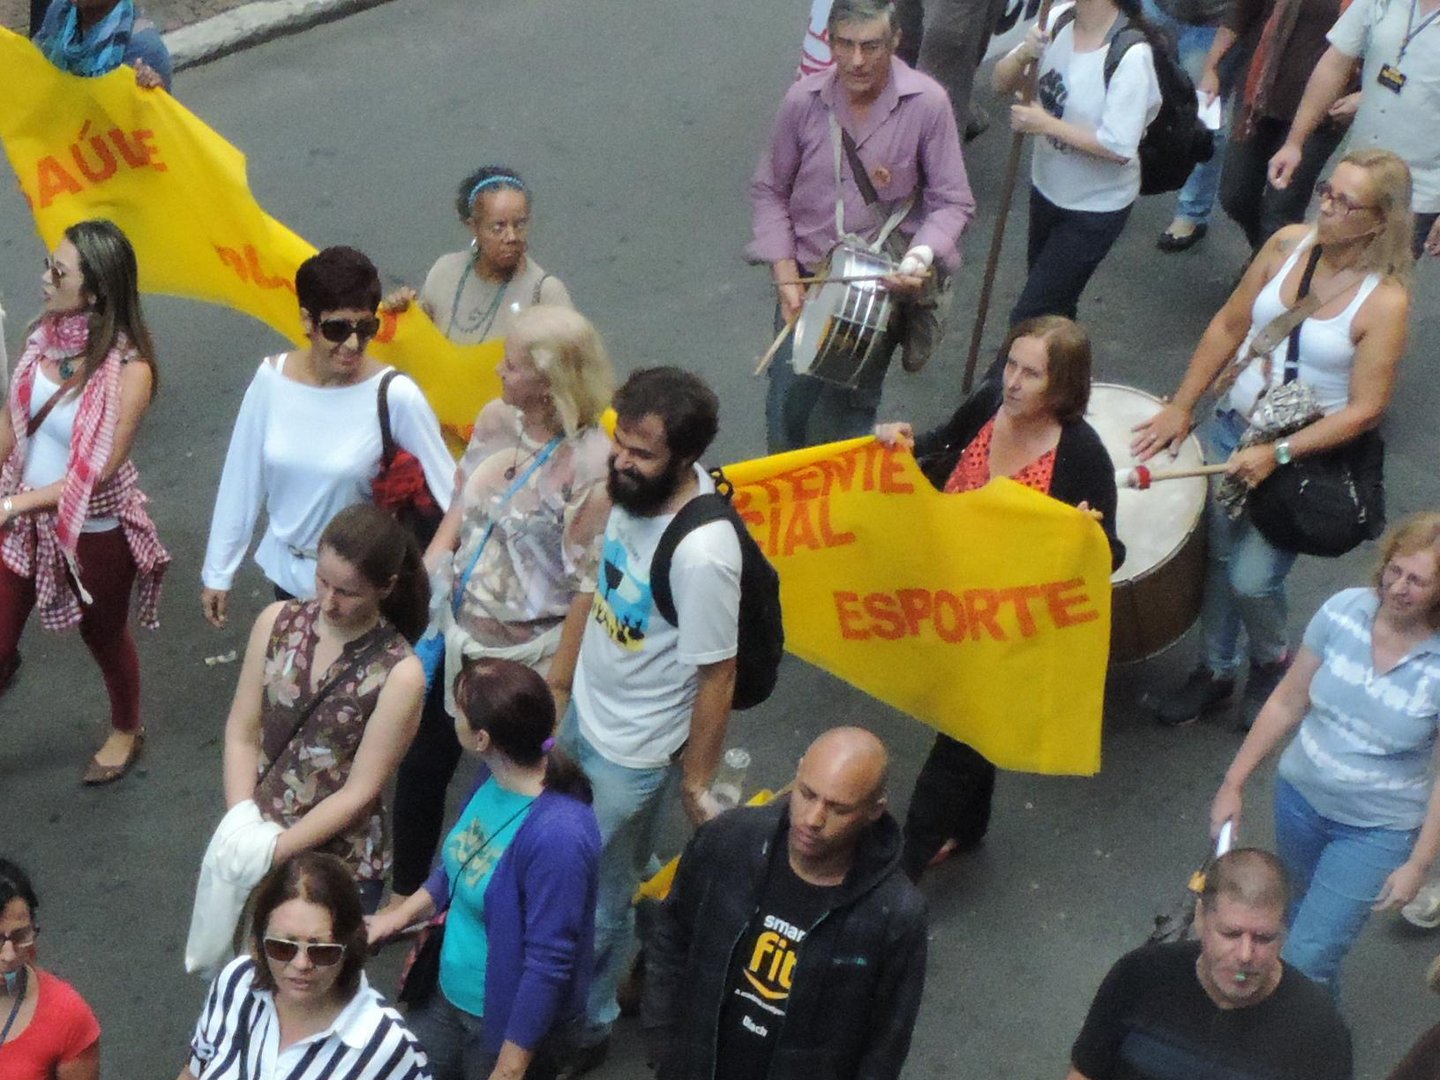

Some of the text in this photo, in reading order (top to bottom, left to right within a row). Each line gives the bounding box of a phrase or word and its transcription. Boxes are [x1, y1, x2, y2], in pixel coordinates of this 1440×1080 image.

[833, 576, 1099, 644] ESPORTE
[763, 914, 807, 943] smar
[748, 931, 797, 989] fit
